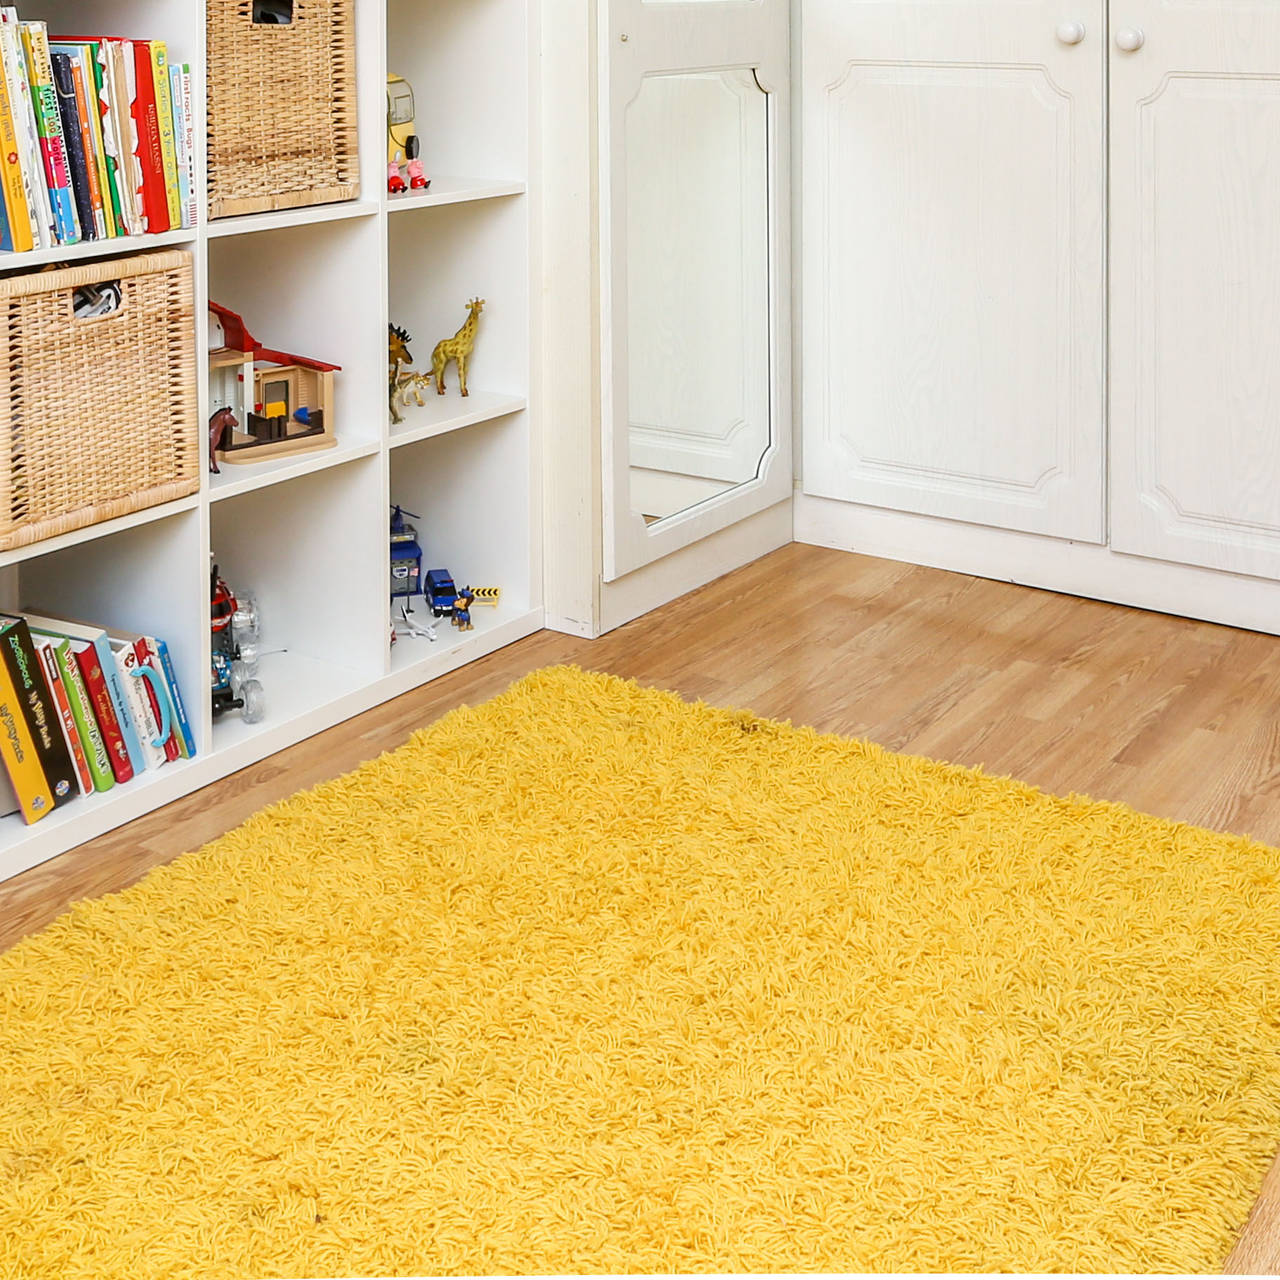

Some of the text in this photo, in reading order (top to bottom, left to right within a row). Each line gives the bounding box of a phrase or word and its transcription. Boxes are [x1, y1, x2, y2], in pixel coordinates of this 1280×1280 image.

[44, 87, 62, 167] first 100 words
